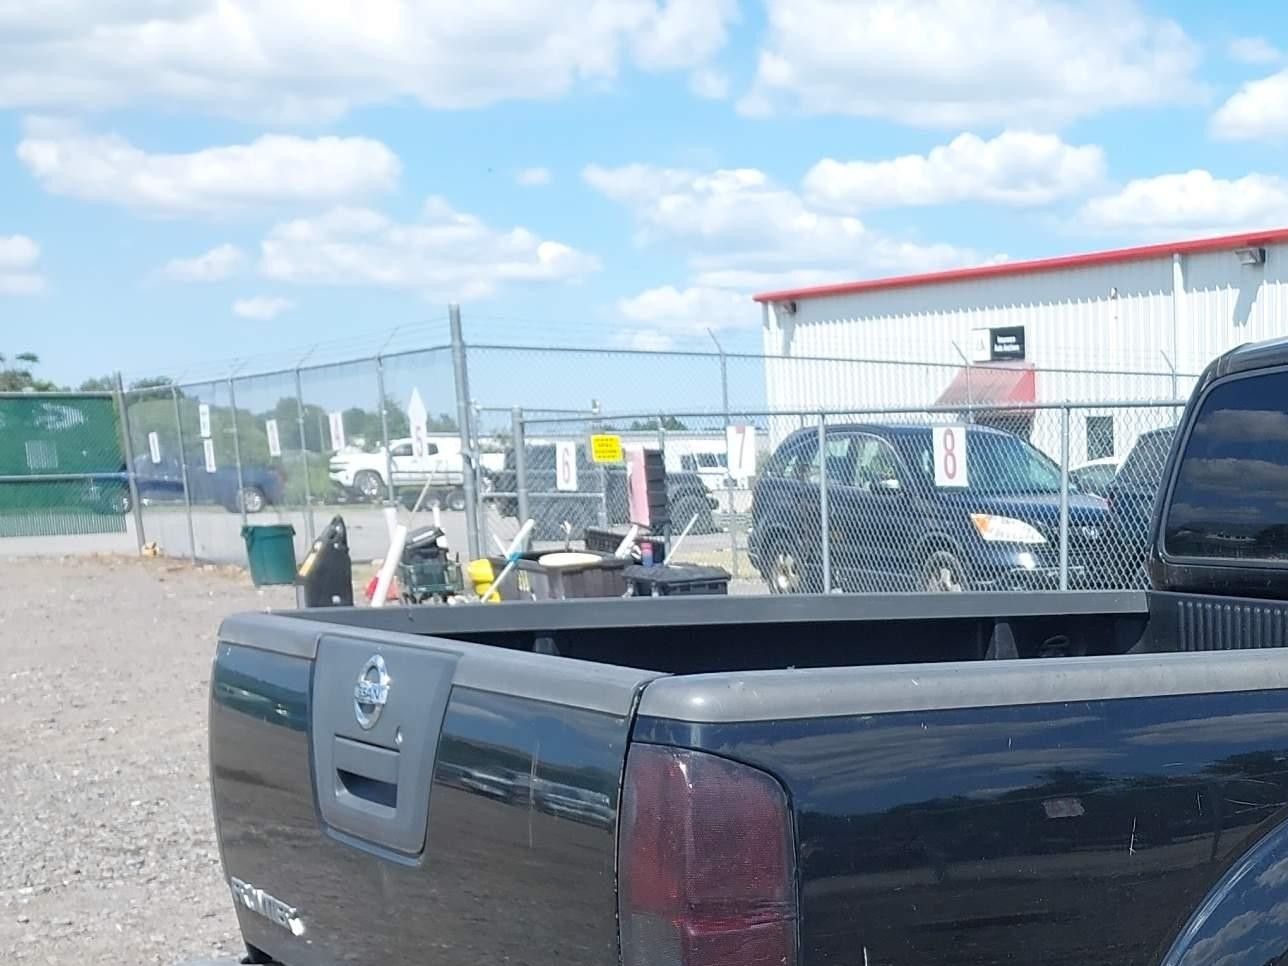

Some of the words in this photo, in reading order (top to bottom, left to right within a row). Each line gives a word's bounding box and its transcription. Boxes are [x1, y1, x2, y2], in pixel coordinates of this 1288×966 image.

[562, 447, 571, 484] 6
[736, 424, 746, 470] 7
[943, 428, 957, 480] 8
